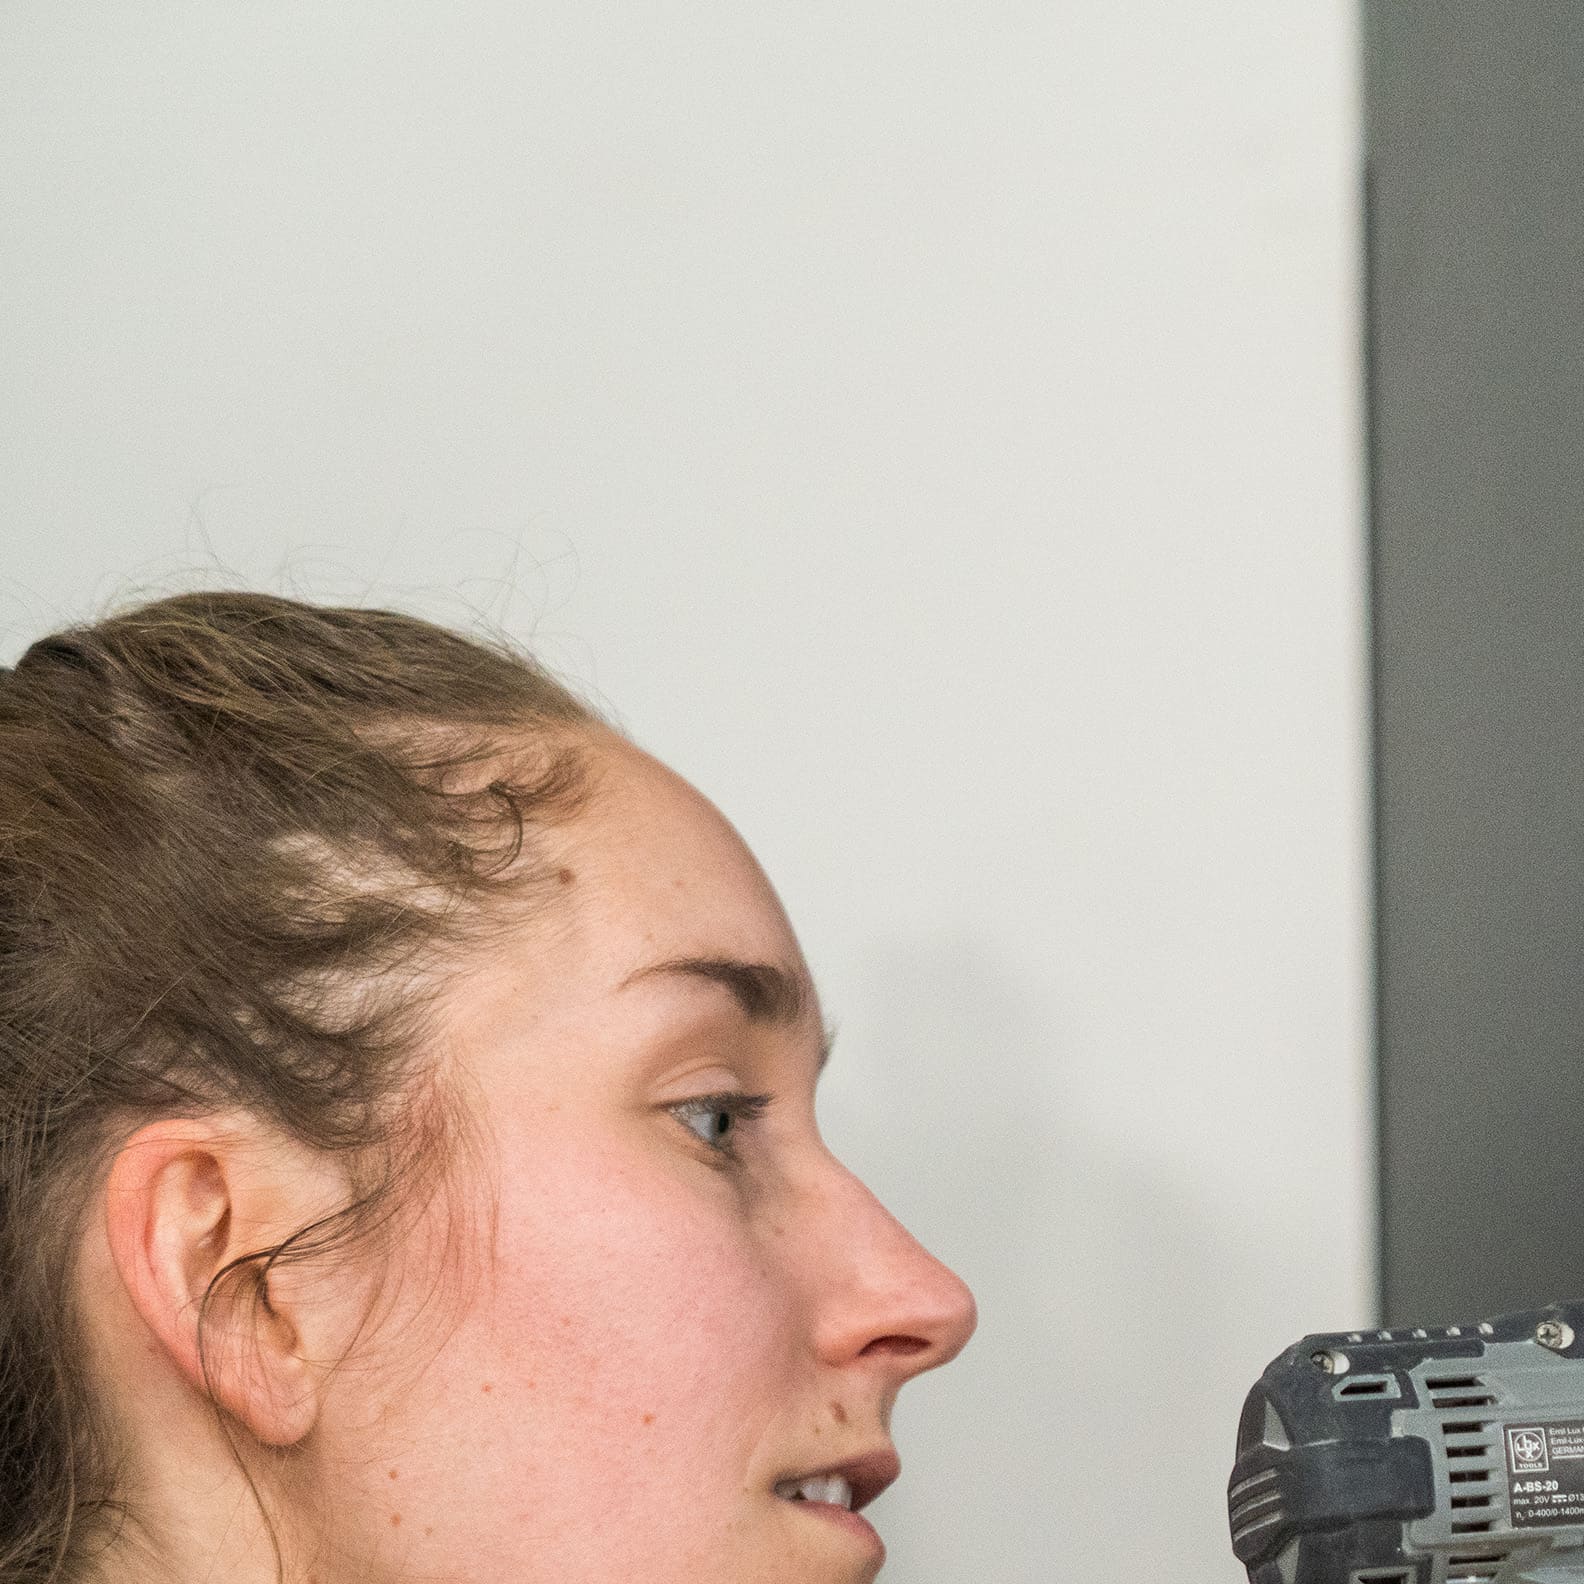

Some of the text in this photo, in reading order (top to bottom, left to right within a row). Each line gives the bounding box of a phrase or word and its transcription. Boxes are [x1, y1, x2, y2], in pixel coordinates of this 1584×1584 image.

[1549, 1427, 1566, 1435] Emil
[1567, 1426, 1581, 1434] Lux
[1514, 1481, 1559, 1493] A-BS-20
[1534, 1495, 1550, 1504] 20V
